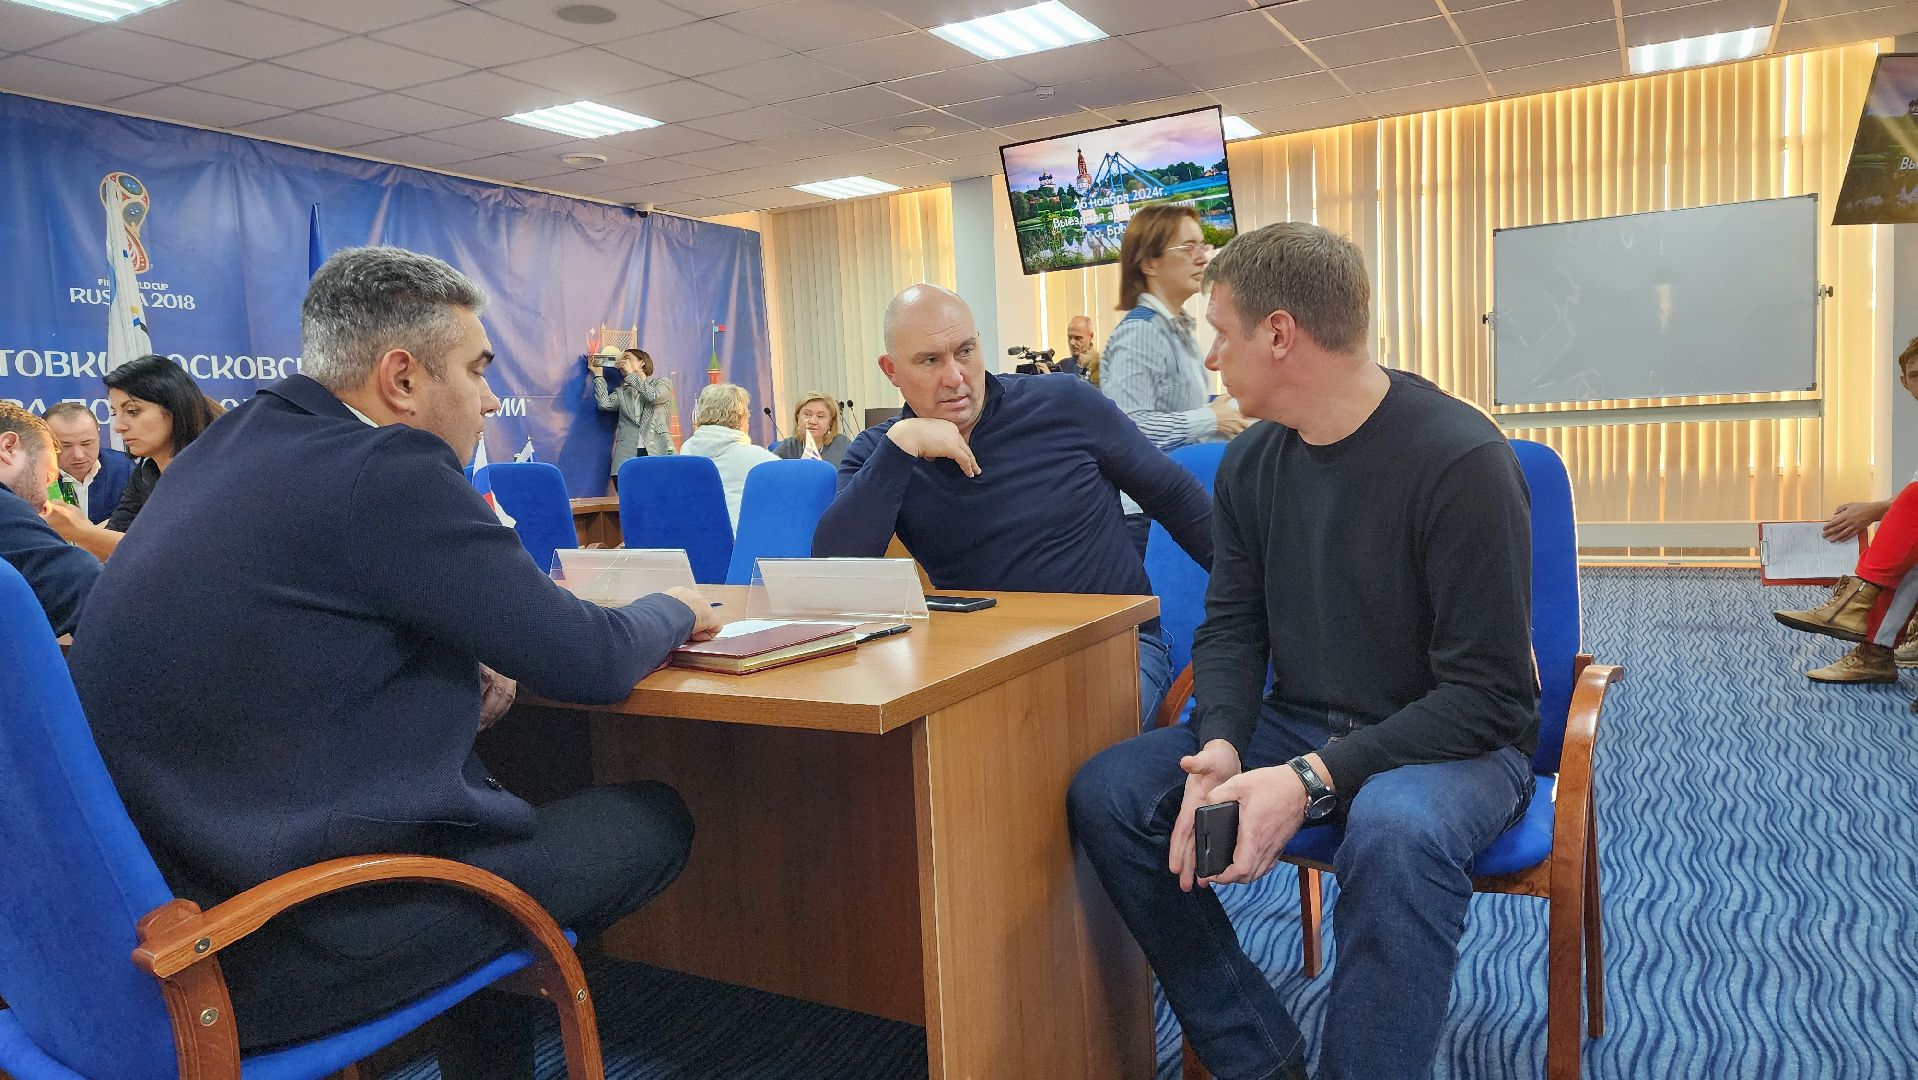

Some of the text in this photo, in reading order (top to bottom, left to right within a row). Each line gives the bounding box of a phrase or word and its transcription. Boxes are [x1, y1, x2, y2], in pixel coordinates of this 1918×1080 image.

[1090, 191, 1129, 207] ноября
[1132, 187, 1168, 201] 2024г.
[151, 282, 169, 291] CUP
[69, 287, 196, 311] RUSA 2018
[166, 353, 302, 380] ОСКОВС
